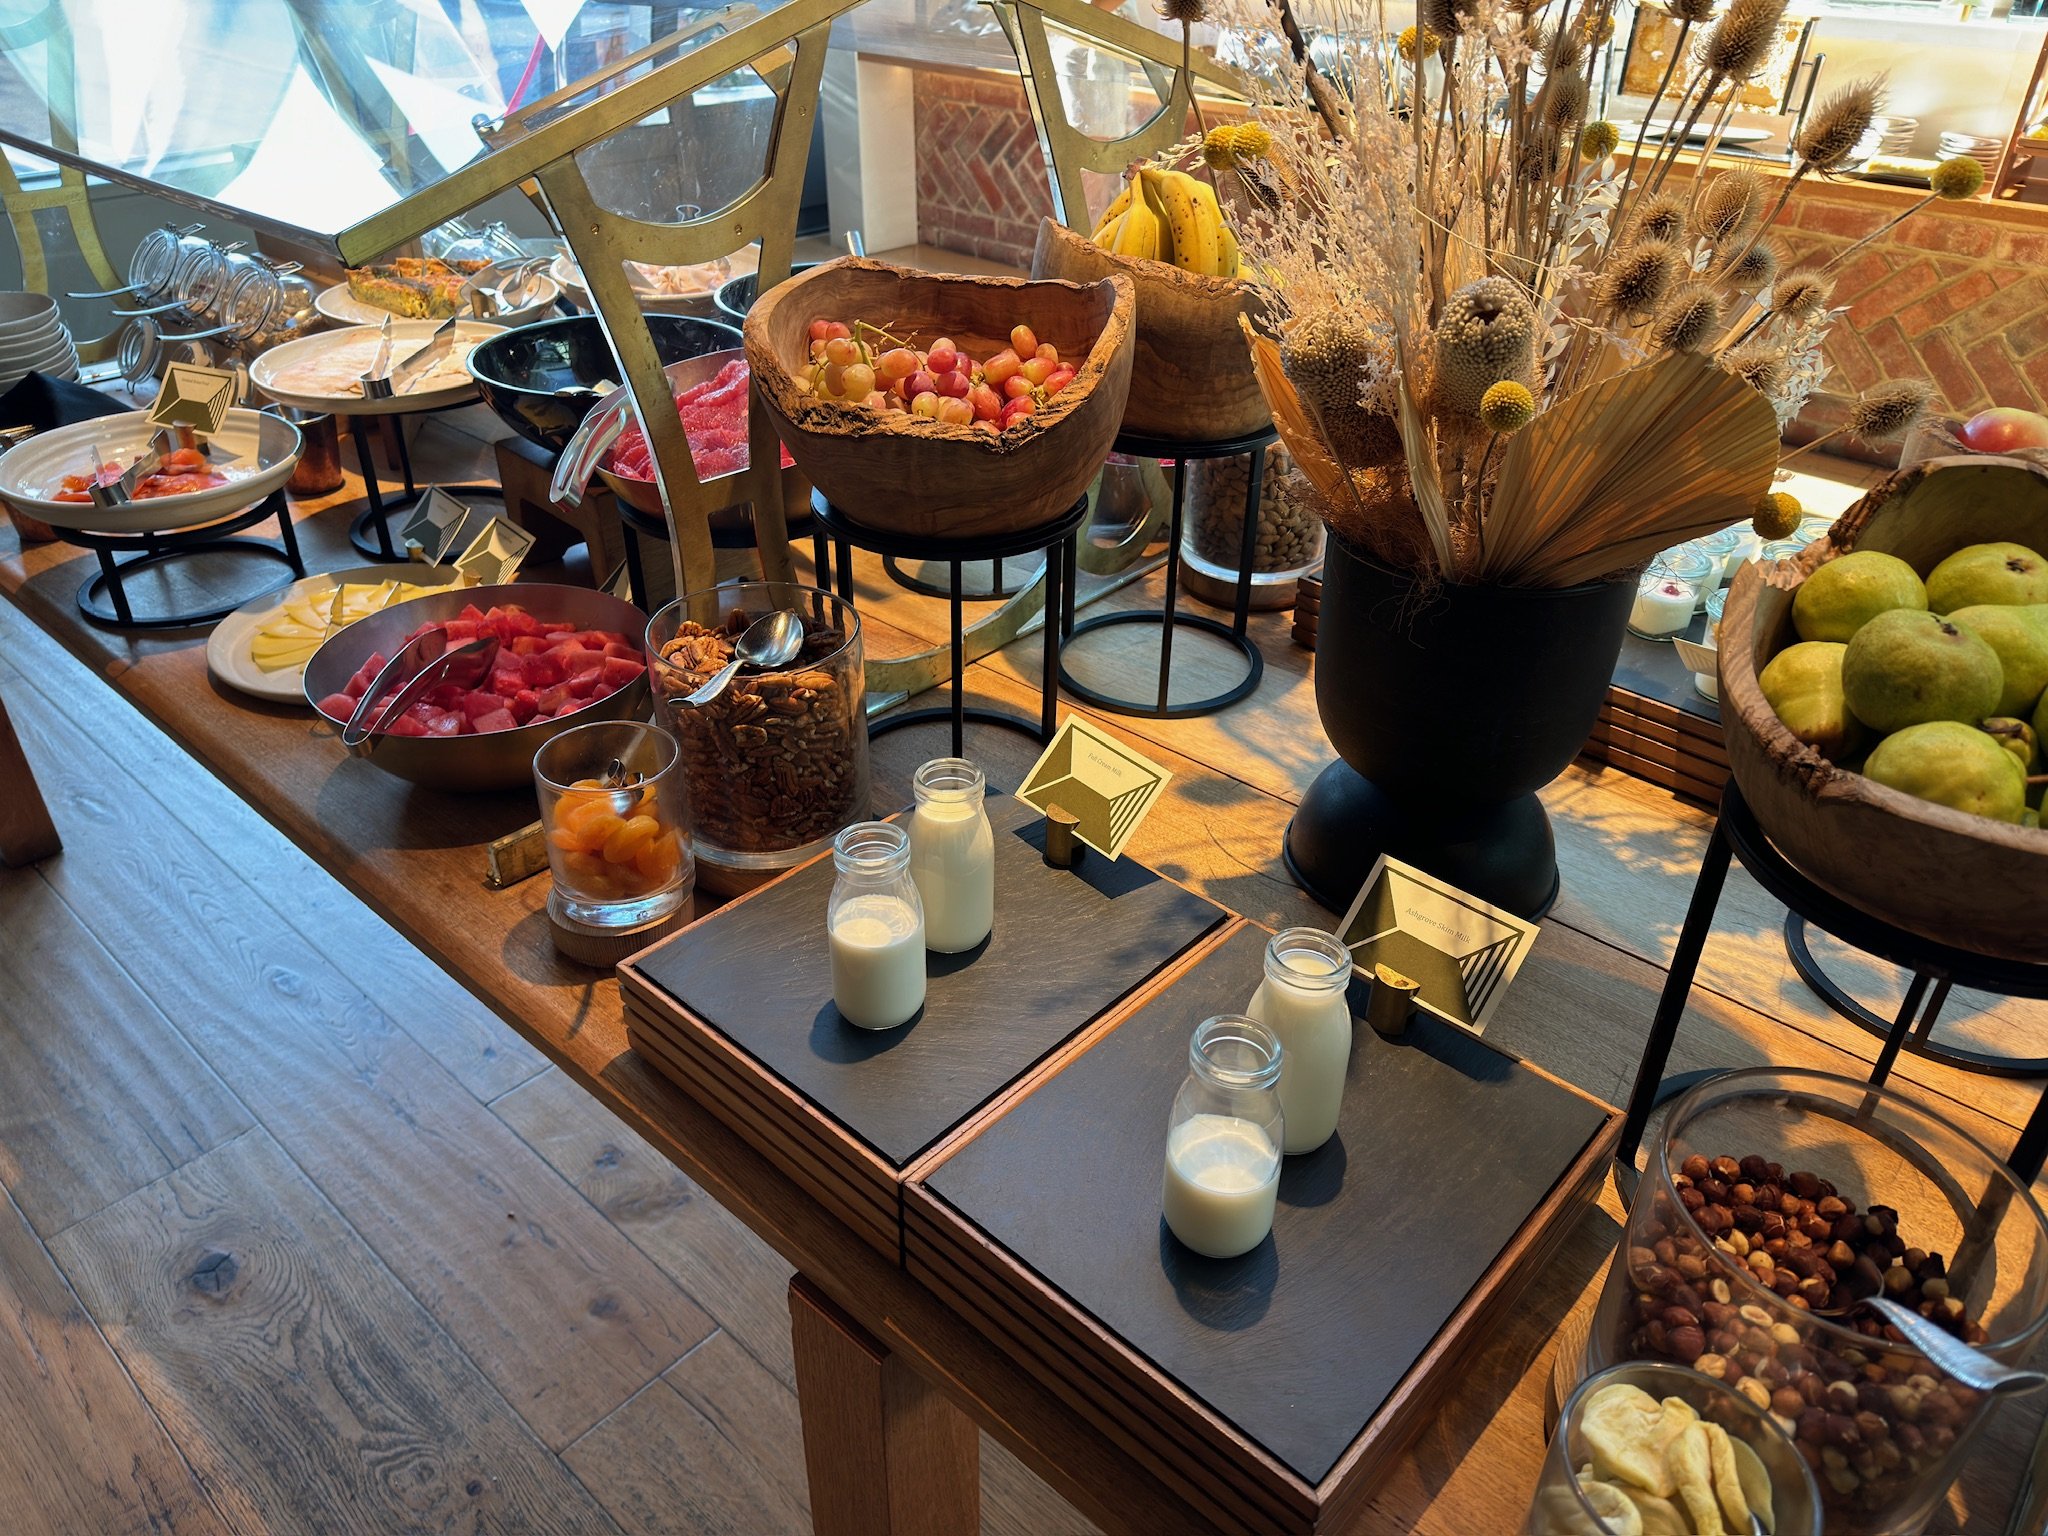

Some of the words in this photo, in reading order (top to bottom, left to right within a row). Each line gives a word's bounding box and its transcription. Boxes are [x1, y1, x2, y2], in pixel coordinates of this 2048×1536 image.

[1097, 758, 1112, 770] Cream
[1112, 766, 1122, 777] Milk
[1406, 908, 1437, 927] Ashgrove
[1437, 922, 1454, 936] Skim
[1454, 930, 1471, 944] Milk
